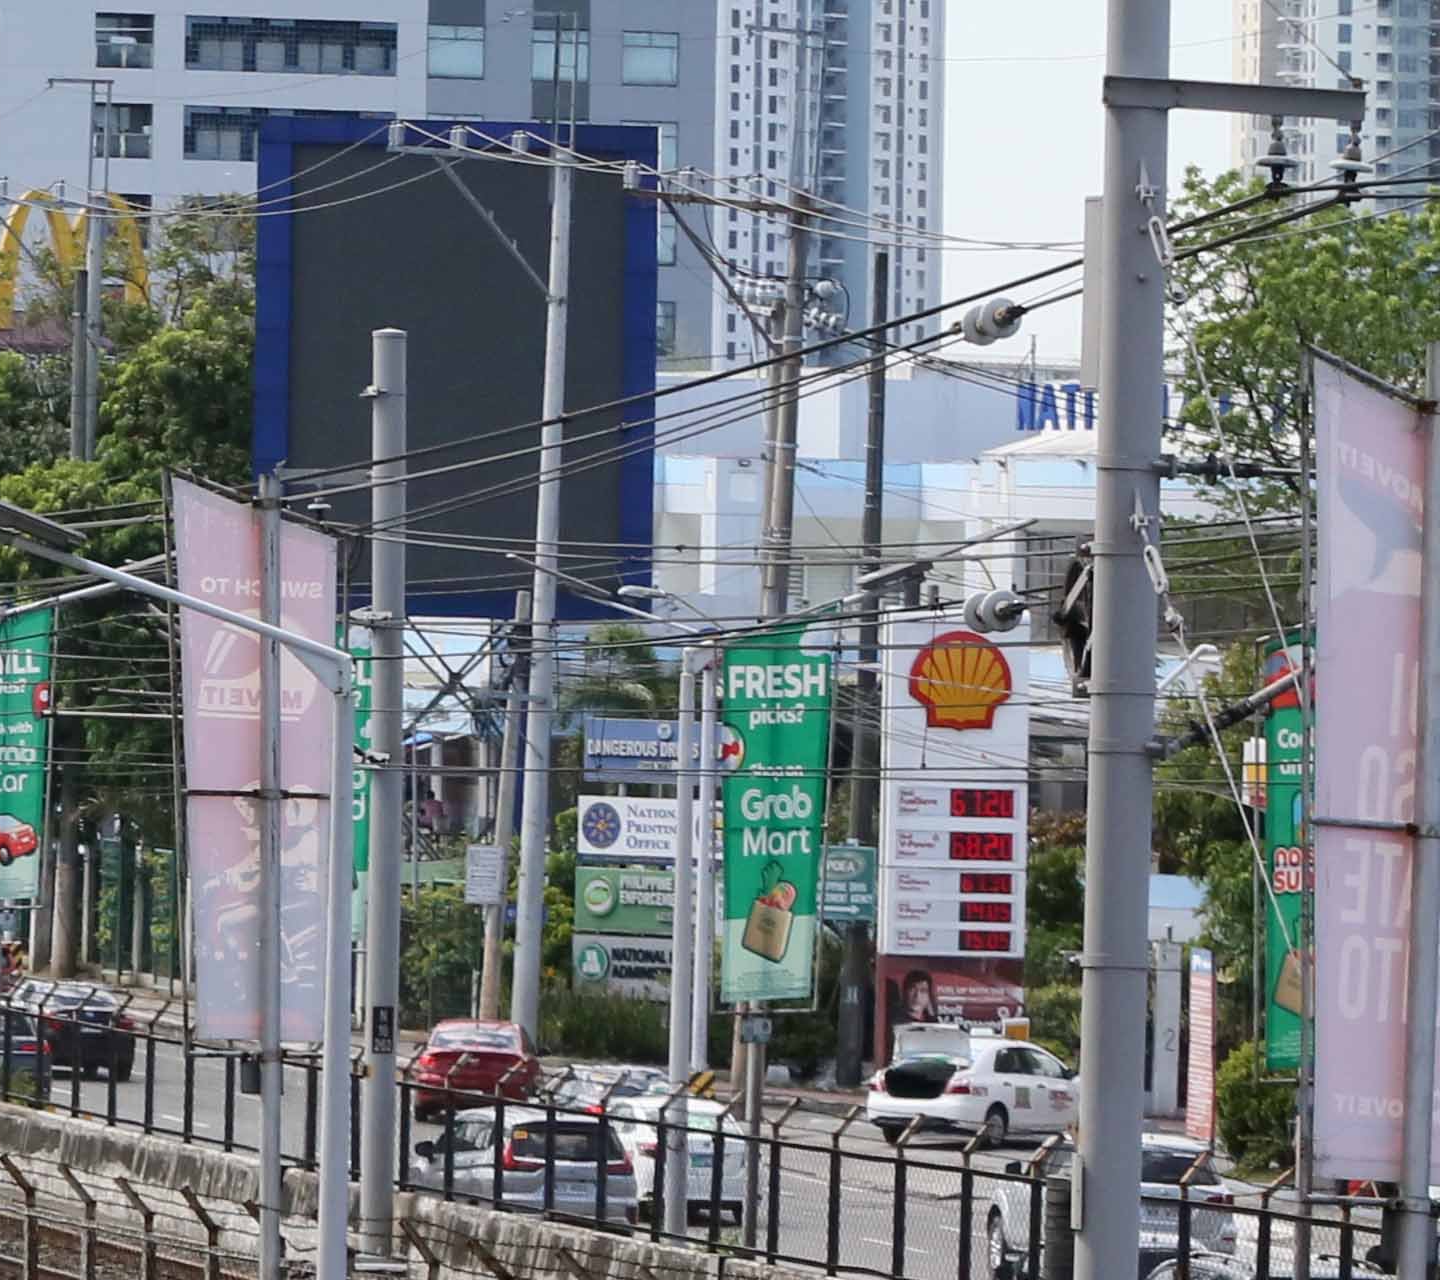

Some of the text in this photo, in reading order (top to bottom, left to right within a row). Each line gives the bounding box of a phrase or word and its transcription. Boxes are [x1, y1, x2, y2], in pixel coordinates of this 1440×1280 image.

[728, 663, 826, 699] FRESH
[749, 704, 806, 731] picks?
[8, 723, 32, 735] with
[587, 739, 657, 758] DANGEROUS
[626, 804, 677, 819] NATION
[741, 785, 813, 821] Grab
[626, 819, 678, 834] PRINTIN
[626, 835, 671, 851] OFFICE
[742, 827, 811, 857] Mart
